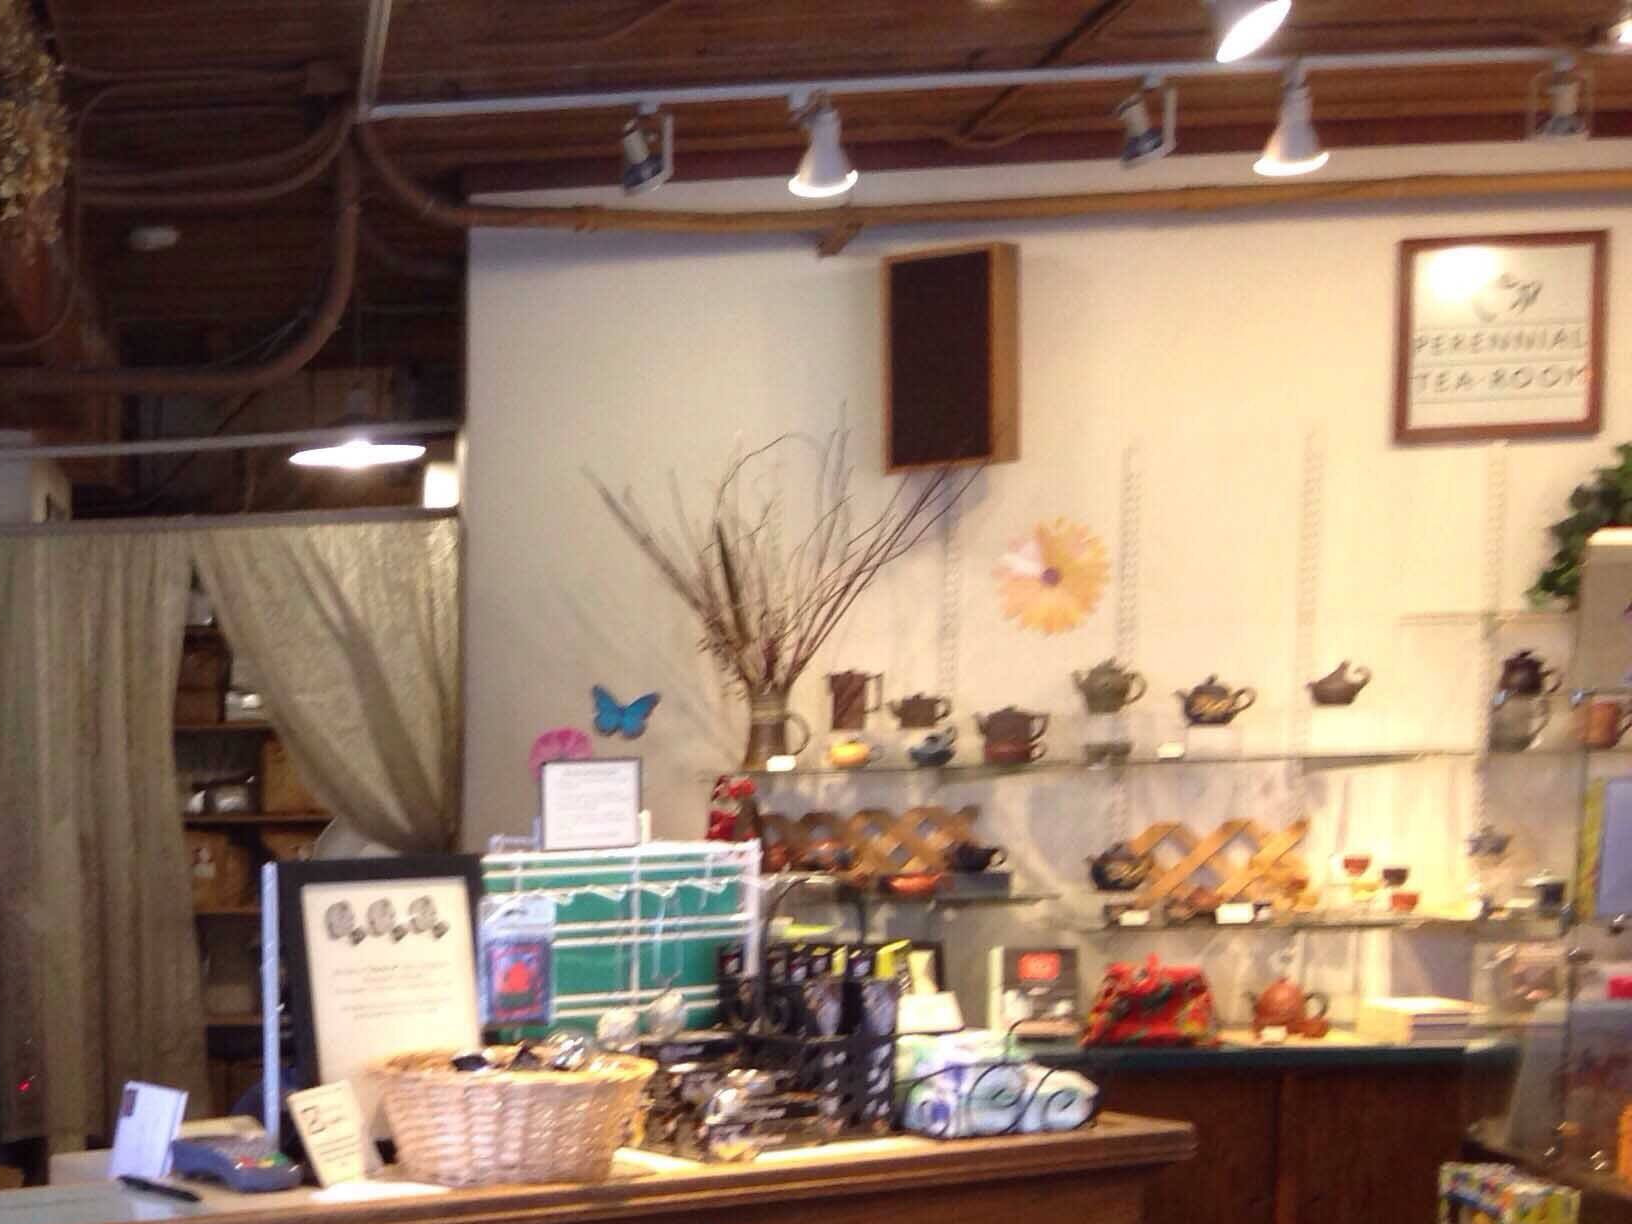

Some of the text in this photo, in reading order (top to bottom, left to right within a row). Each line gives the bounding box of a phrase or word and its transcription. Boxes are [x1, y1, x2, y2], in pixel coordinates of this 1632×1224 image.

[1414, 327, 1588, 355] PERENNIAL
[1412, 365, 1593, 393] TEA ROOM
